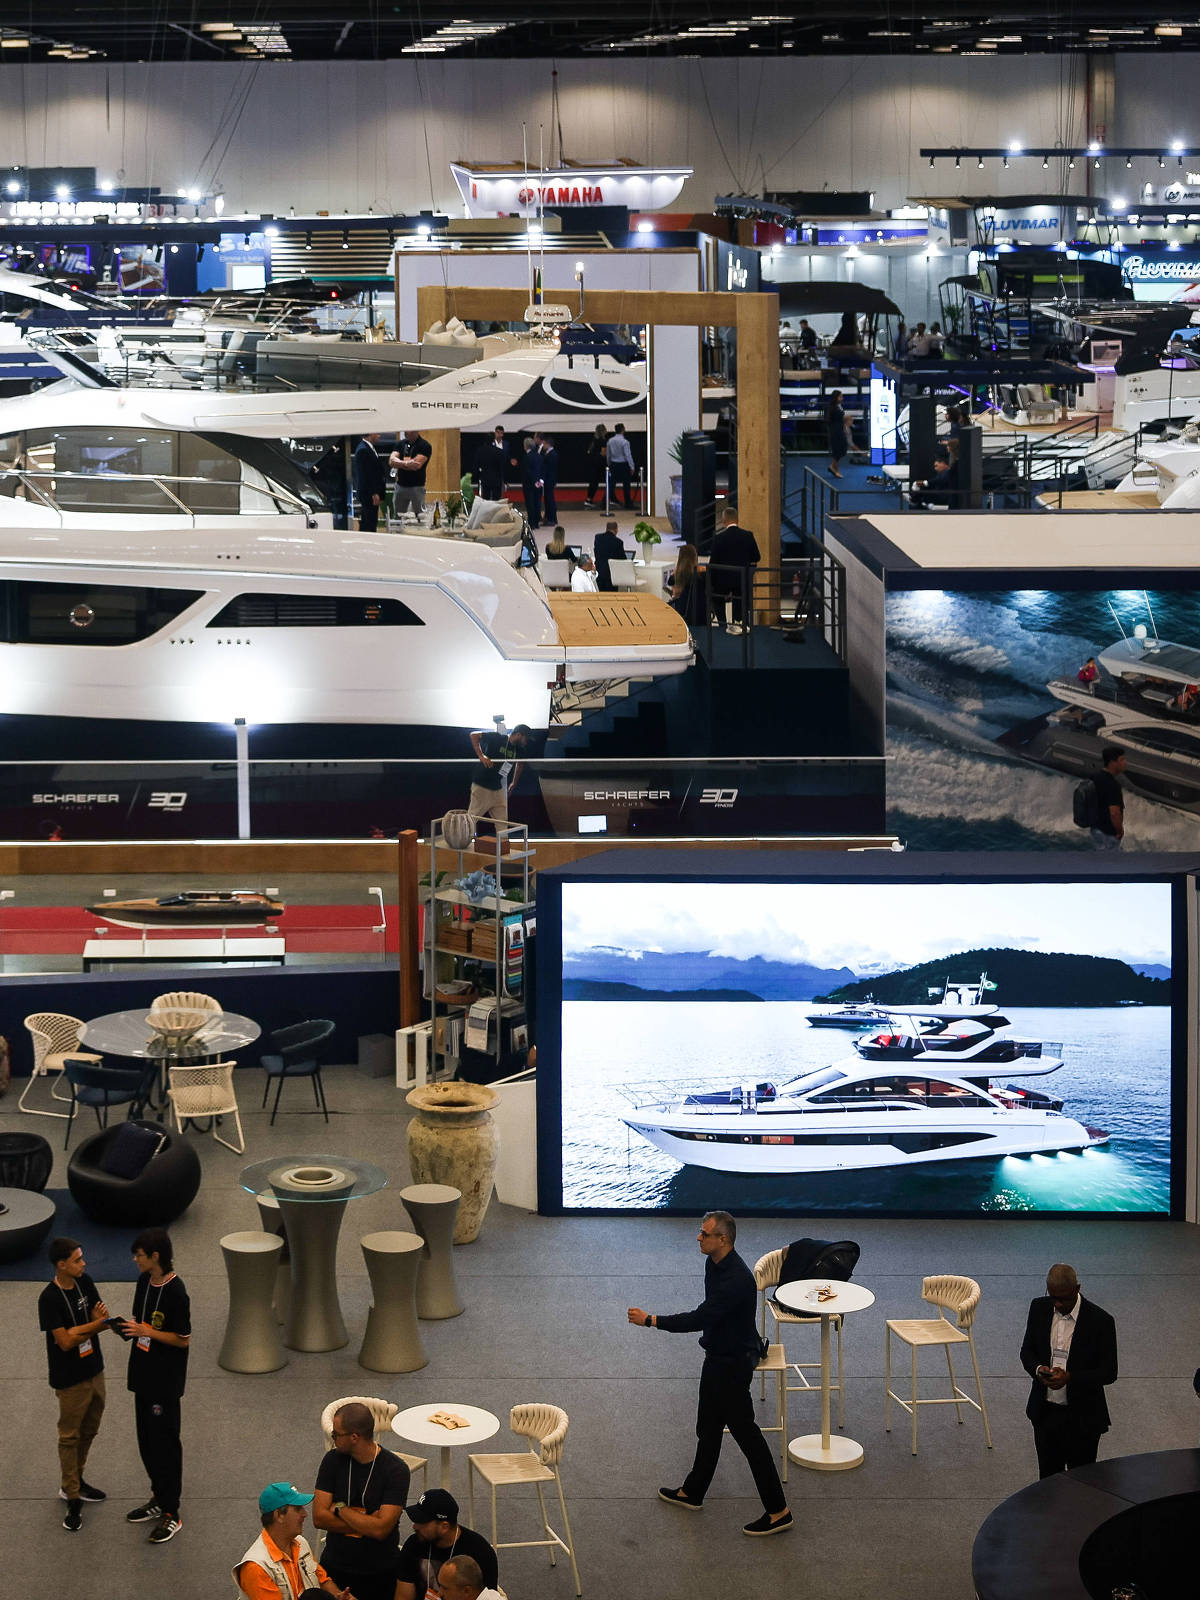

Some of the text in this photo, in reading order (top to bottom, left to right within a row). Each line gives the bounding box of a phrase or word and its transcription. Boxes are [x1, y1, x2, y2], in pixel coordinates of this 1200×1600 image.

[538, 187, 604, 204] YAMAHA
[984, 217, 1058, 232] FLUVIMAR
[411, 401, 479, 409] SCHAEFER
[32, 792, 187, 807] SCHAEFER 30
[584, 788, 739, 803] SCHAEFER 30
